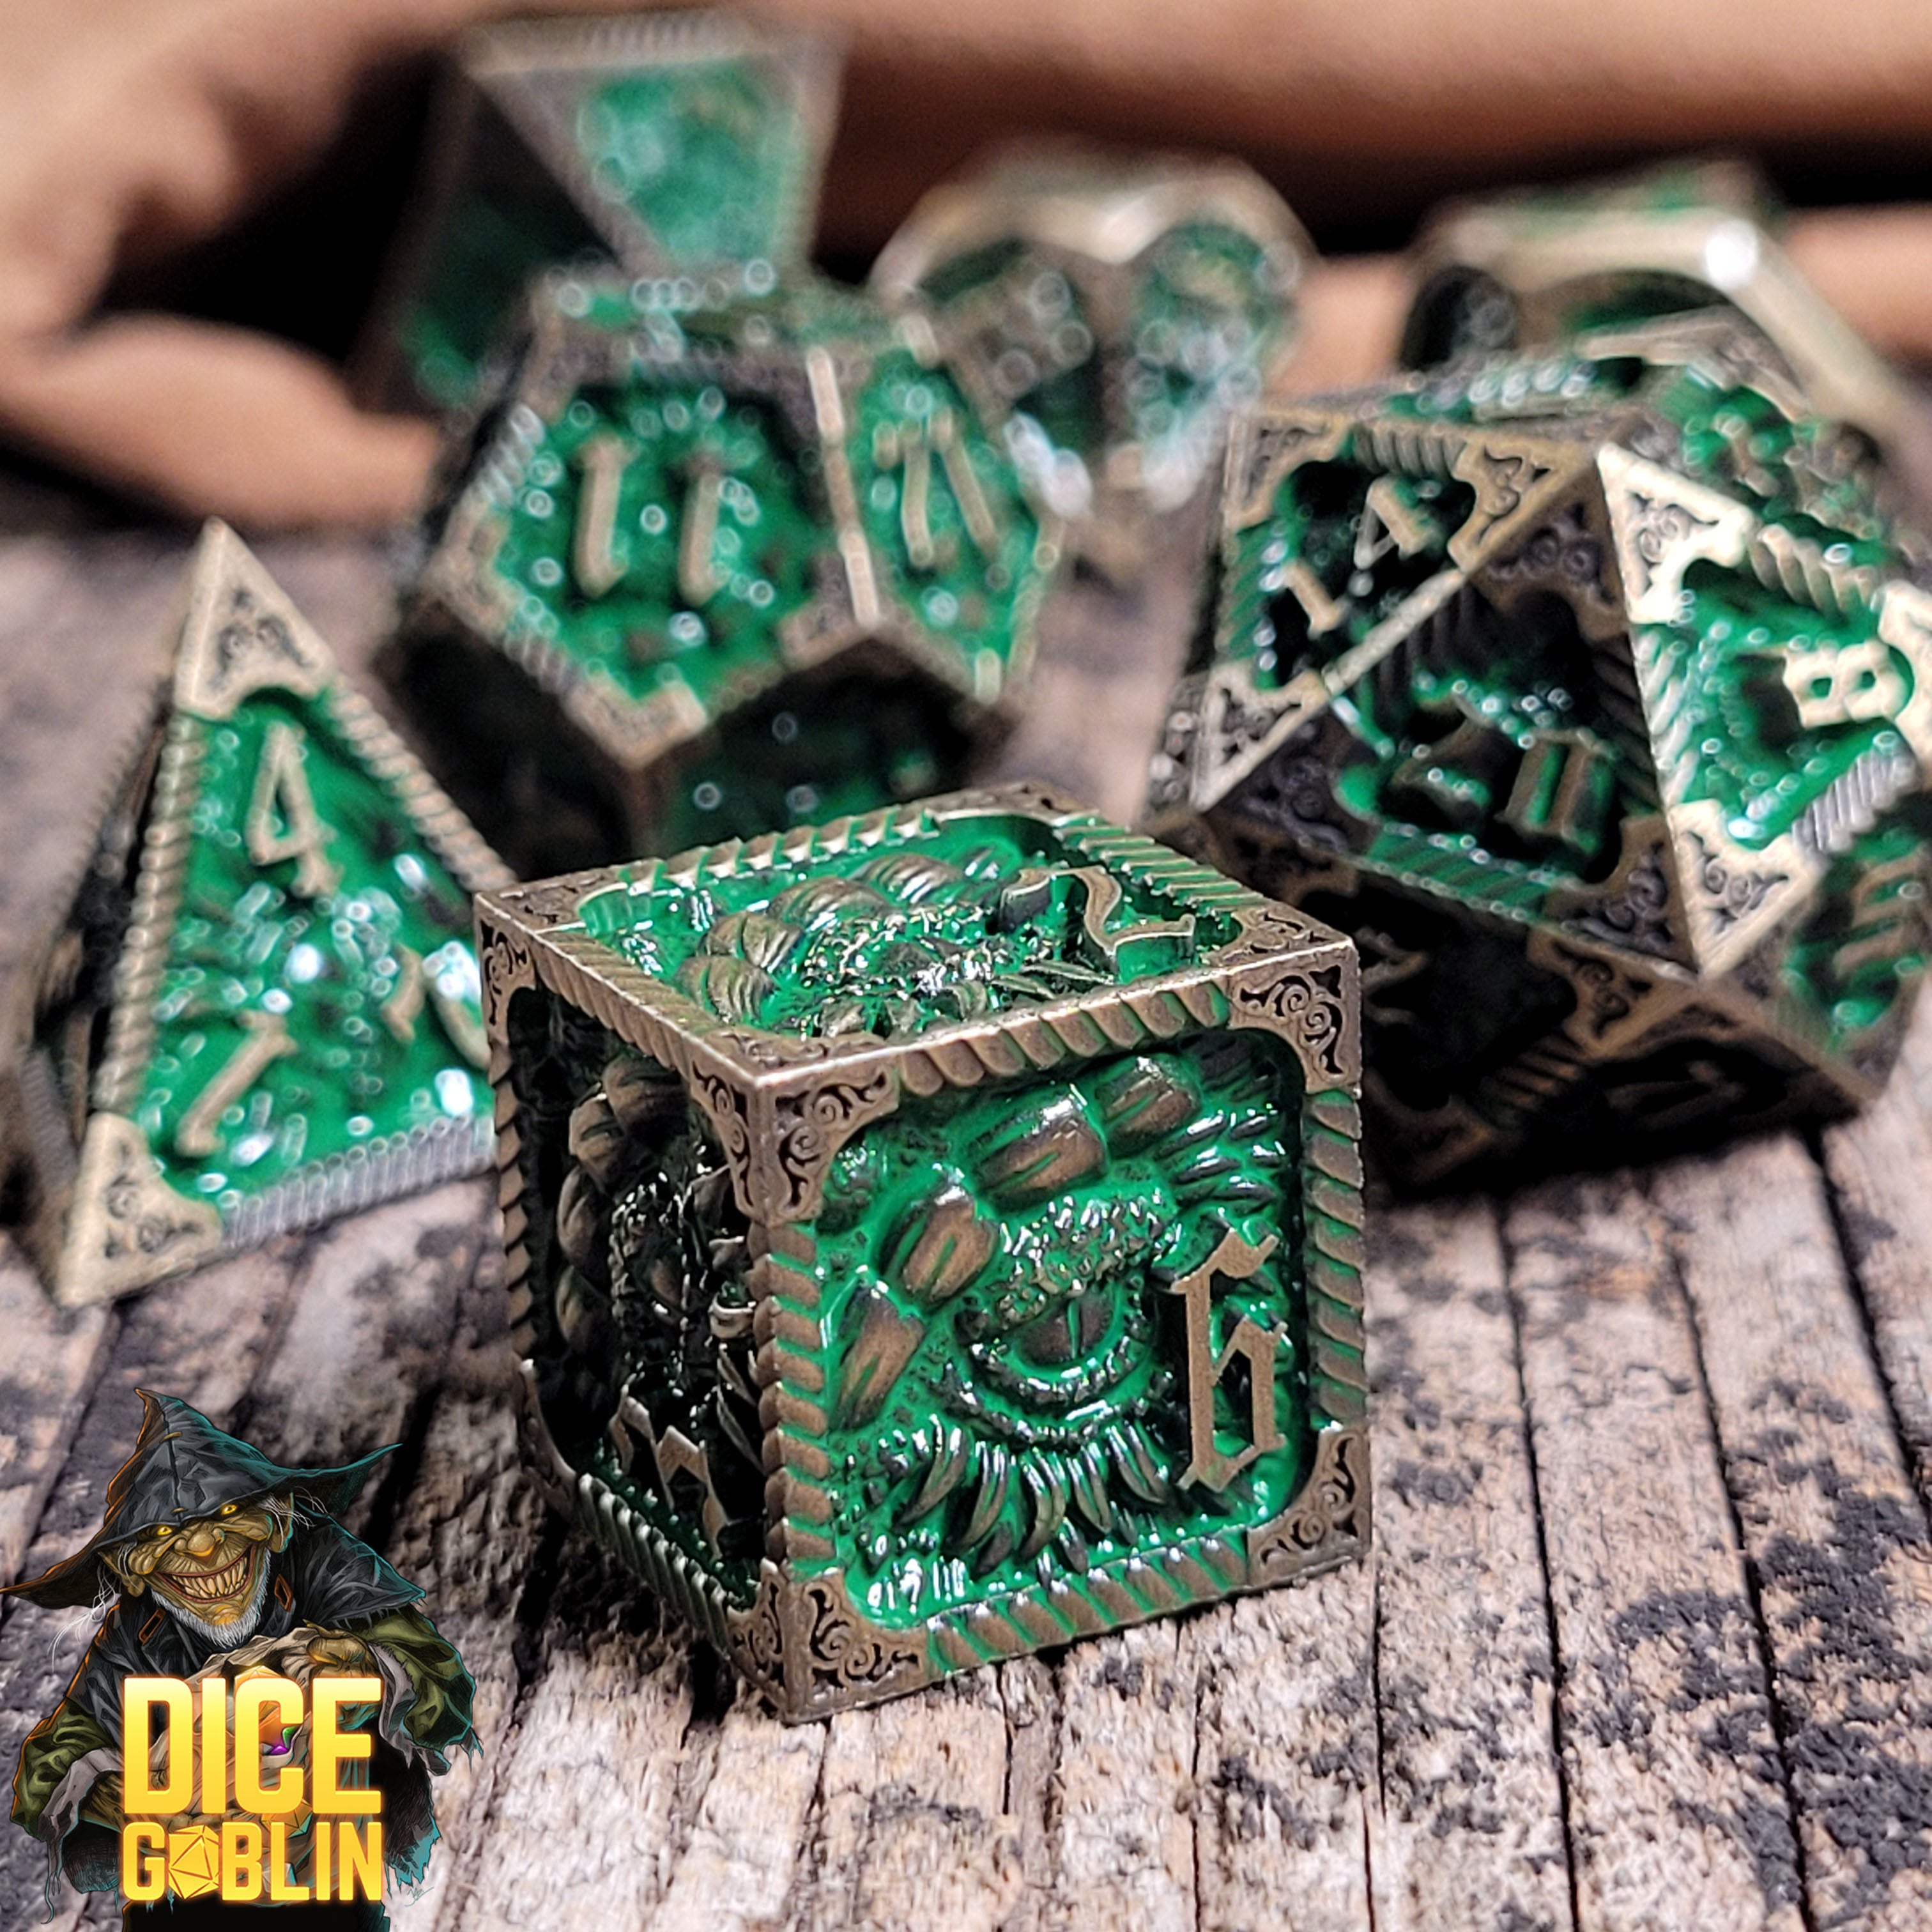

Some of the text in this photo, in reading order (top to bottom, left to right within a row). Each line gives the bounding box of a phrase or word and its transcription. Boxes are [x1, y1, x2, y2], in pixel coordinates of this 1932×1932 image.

[1782, 640, 1907, 729] 8
[247, 719, 344, 897] 4
[1171, 1226, 1286, 1494] 6
